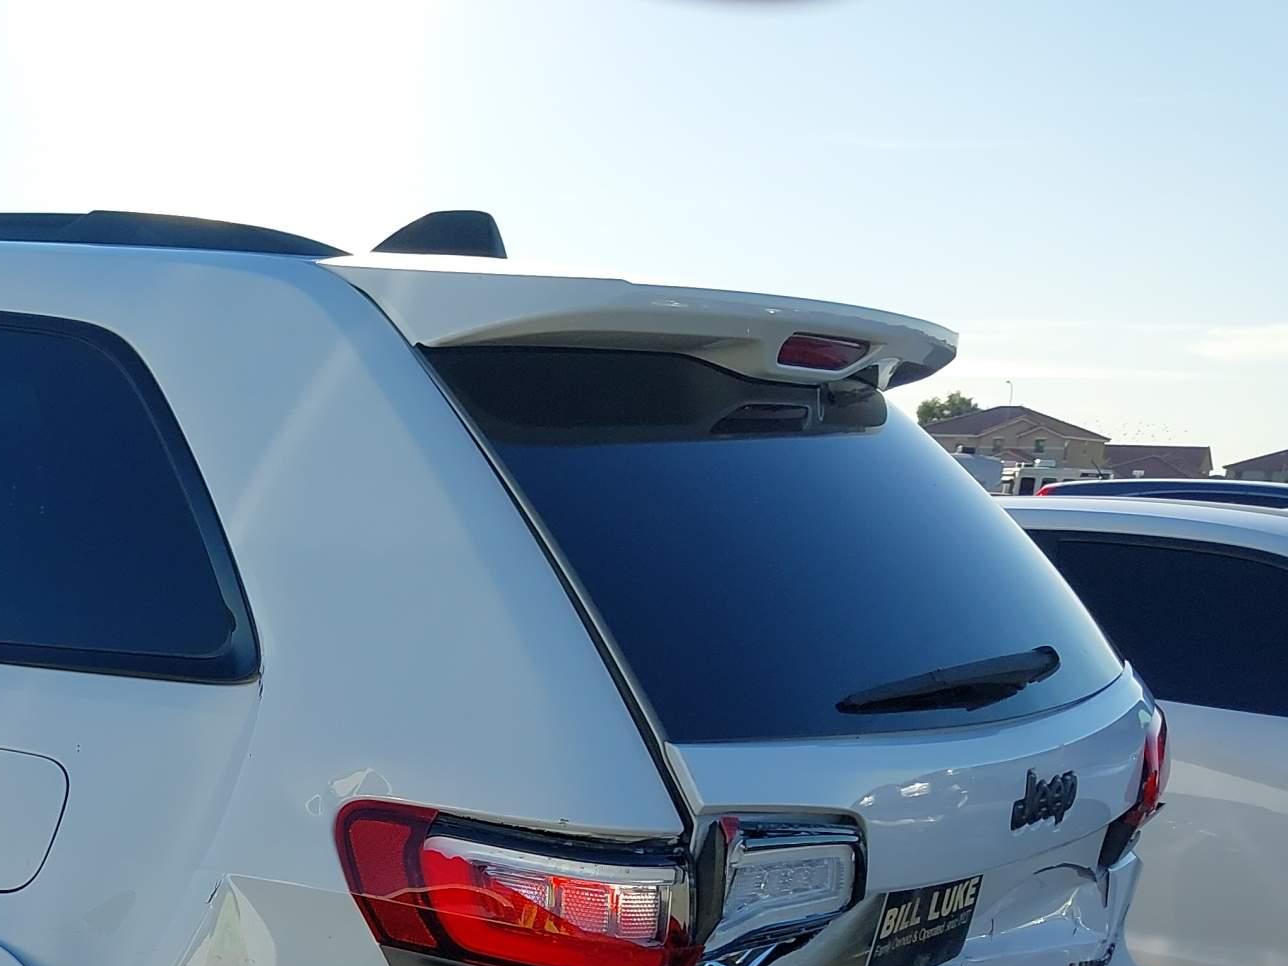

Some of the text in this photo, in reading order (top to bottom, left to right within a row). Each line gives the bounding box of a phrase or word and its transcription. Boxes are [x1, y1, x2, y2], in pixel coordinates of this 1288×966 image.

[1011, 769, 1077, 831] Jeep
[879, 897, 921, 940] BILL
[928, 877, 979, 920] LUKE
